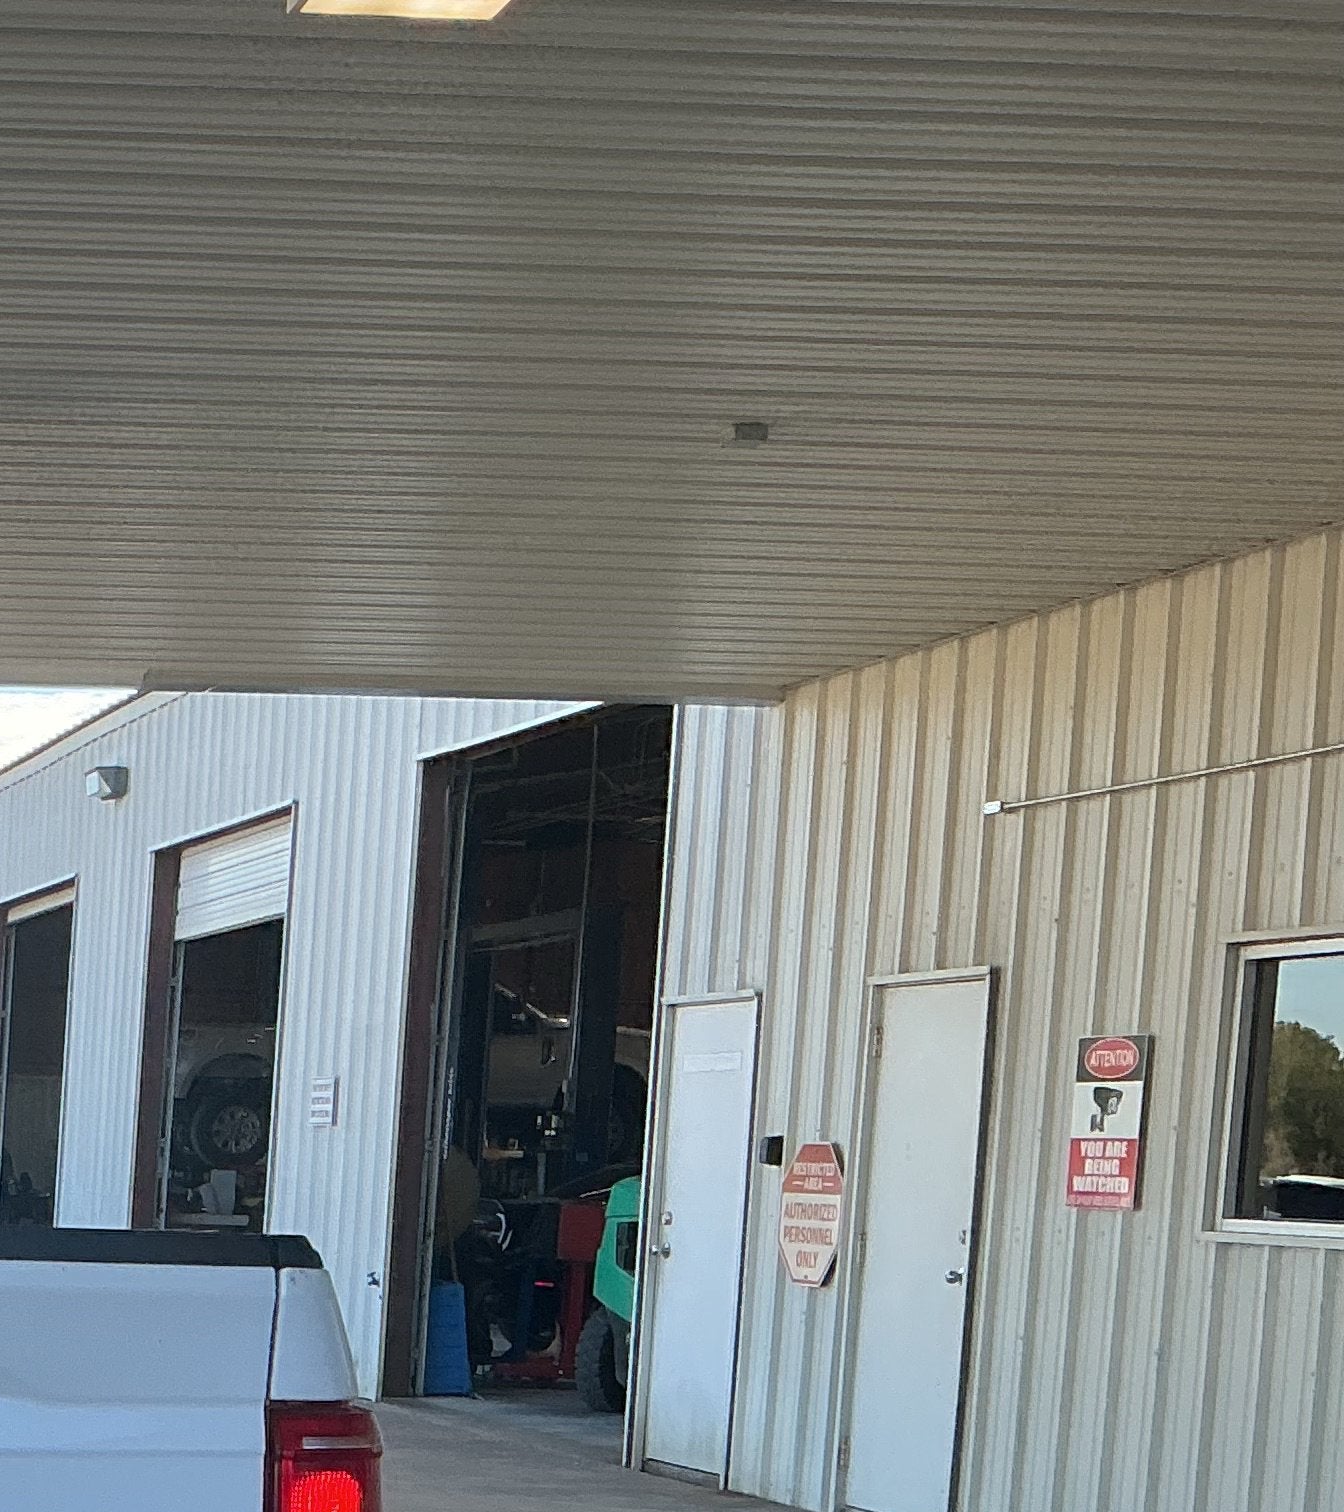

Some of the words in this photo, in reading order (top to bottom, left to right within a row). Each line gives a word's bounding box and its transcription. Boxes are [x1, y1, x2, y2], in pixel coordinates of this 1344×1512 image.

[1089, 1050, 1134, 1067] ATTENTION
[1080, 1140, 1104, 1157] YOU
[1105, 1141, 1128, 1158] ARE
[1084, 1159, 1120, 1175] BEING
[1072, 1175, 1129, 1193] WATCHED
[784, 1203, 838, 1222] AUTHORIZED
[783, 1226, 833, 1245] PERSONNEL
[796, 1250, 819, 1268] ONLY
